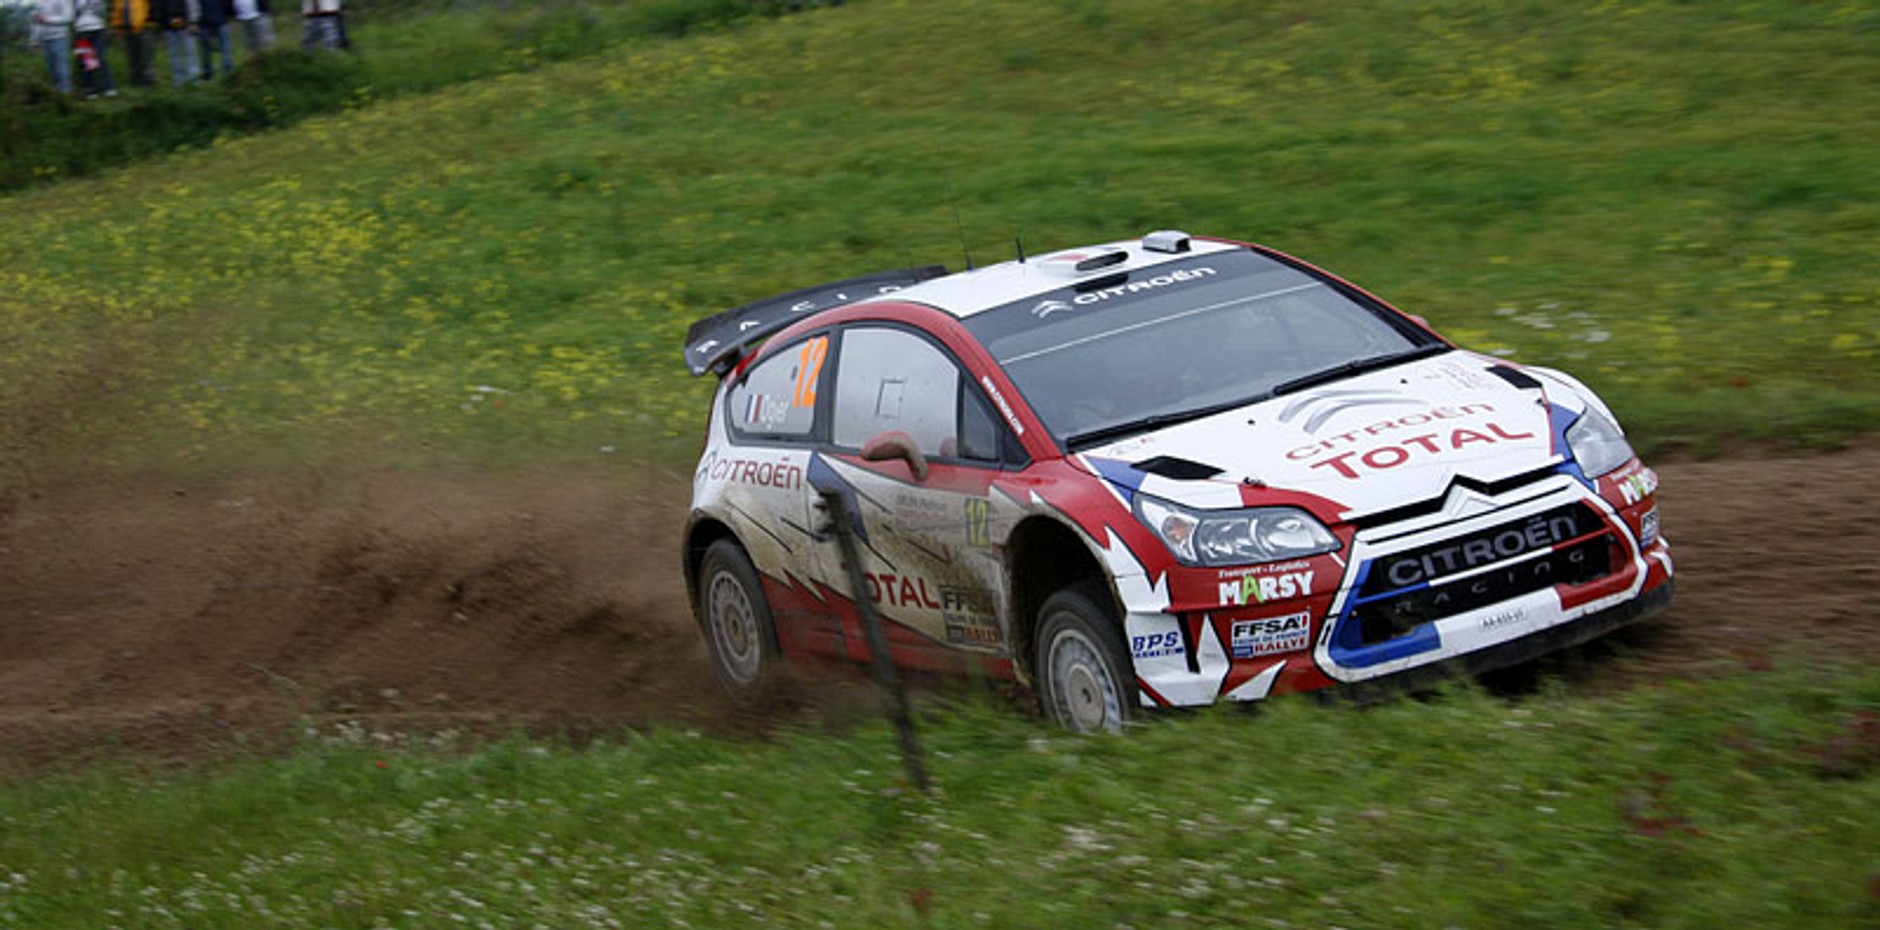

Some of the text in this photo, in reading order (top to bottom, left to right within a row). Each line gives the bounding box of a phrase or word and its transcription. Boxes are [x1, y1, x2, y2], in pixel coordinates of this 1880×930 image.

[792, 335, 829, 408] 12
[1309, 422, 1535, 480] TOTAL
[965, 497, 990, 547] 12
[842, 562, 940, 609] OTAL
[1219, 571, 1315, 607] MARSY
[1132, 631, 1179, 651] BPS
